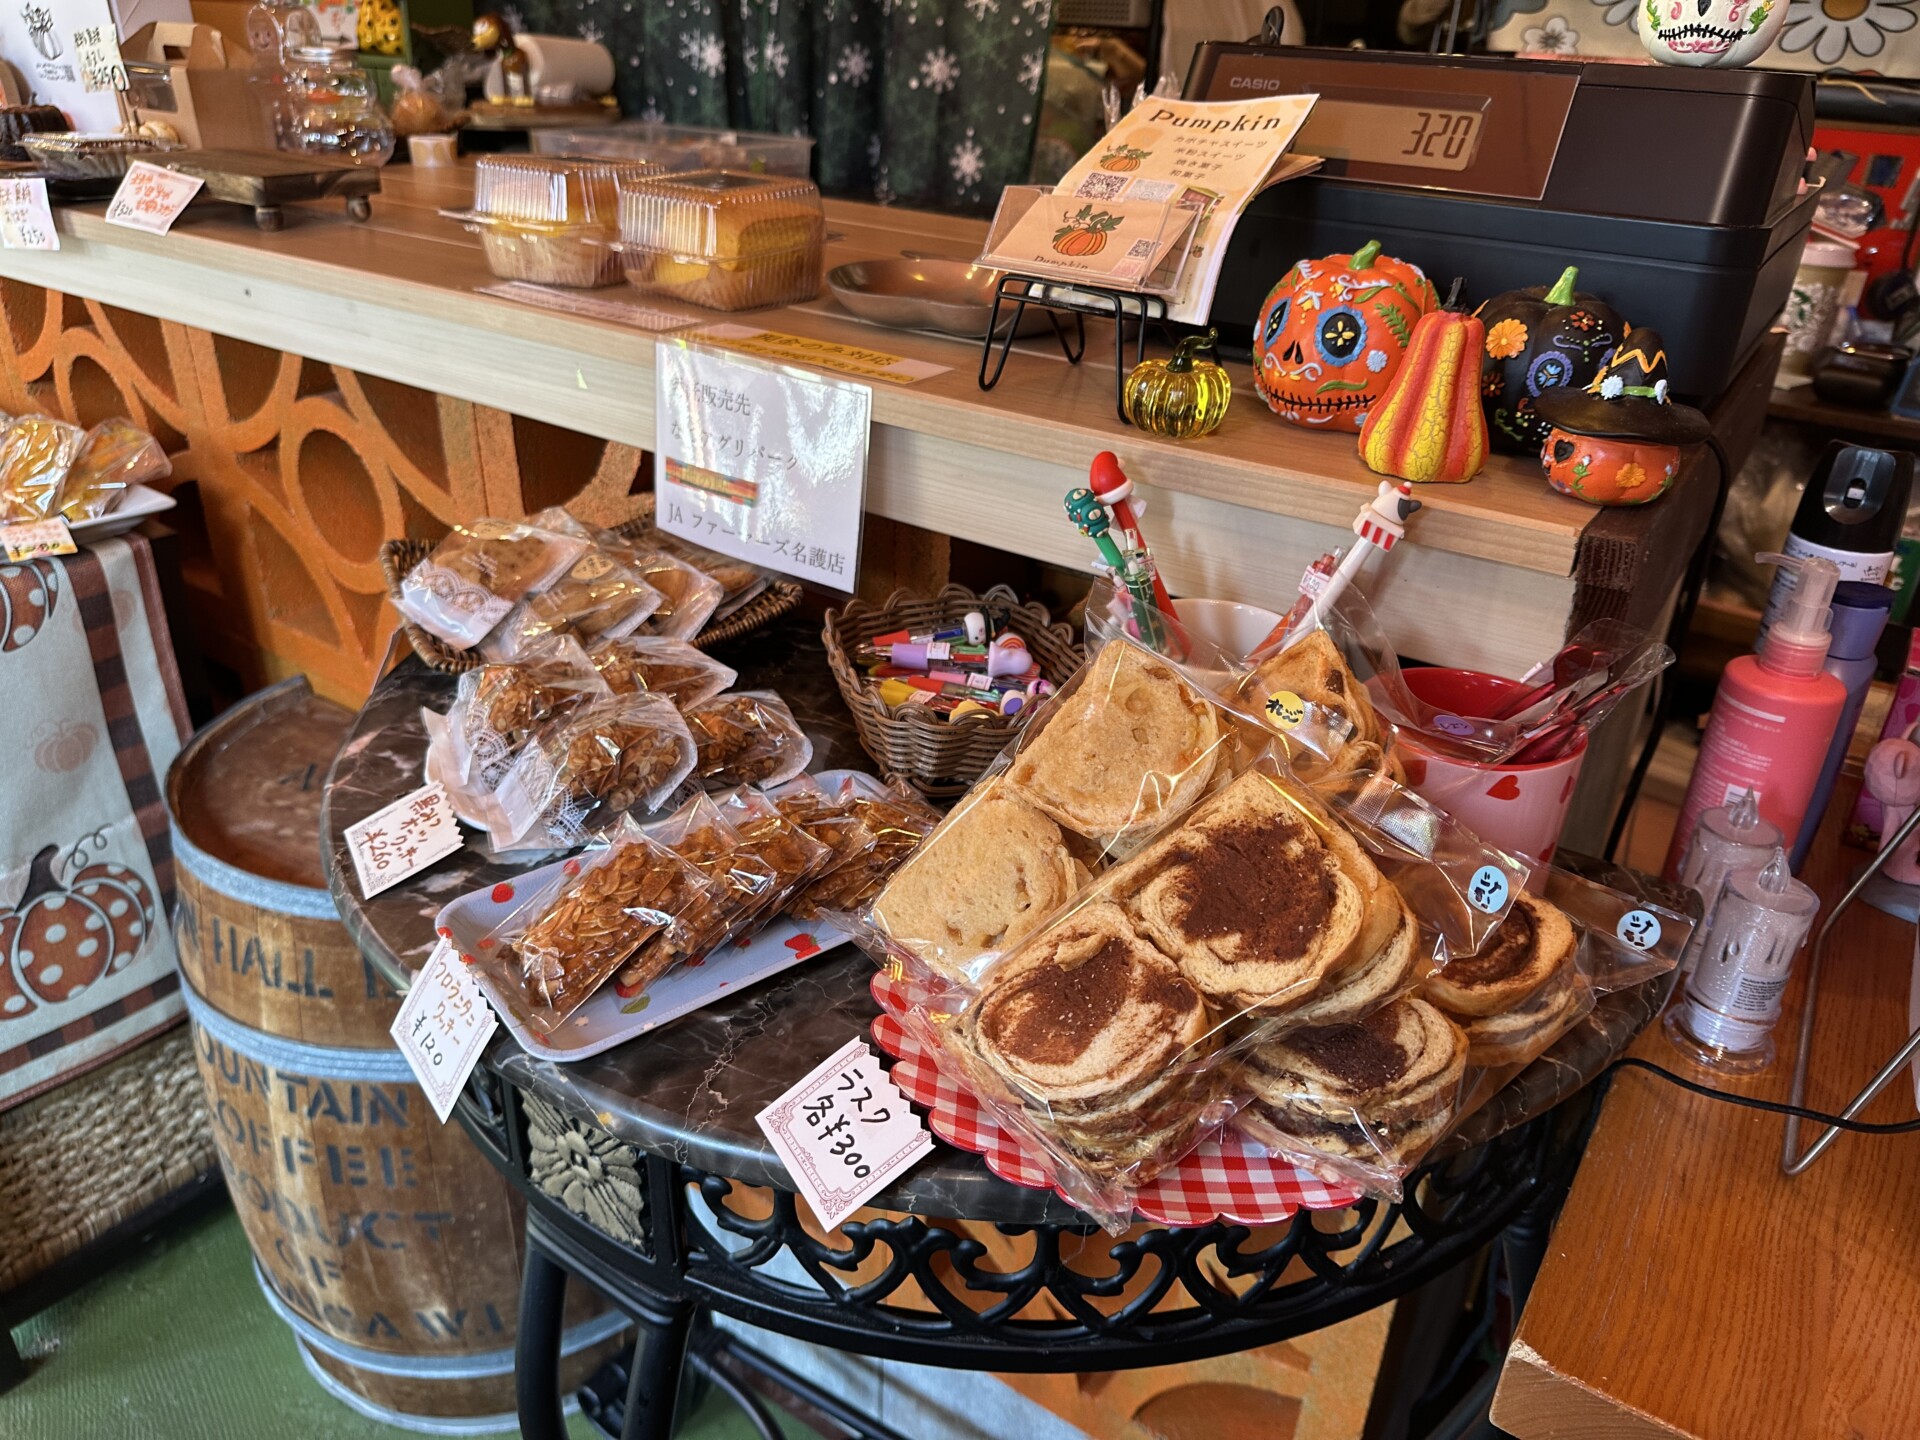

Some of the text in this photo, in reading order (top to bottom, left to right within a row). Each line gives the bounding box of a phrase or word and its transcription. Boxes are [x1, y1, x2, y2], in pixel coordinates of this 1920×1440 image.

[1229, 76, 1280, 91] CASIO
[1149, 108, 1281, 133] Pumpkin
[1173, 136, 1268, 149] カボチャスイーツ
[1402, 112, 1474, 160] 320
[1174, 147, 1247, 161] 米粉スイーツ
[667, 502, 684, 525] JA
[360, 828, 393, 870] ¥260
[212, 916, 335, 998] HALL
[412, 1009, 443, 1067] ¥120
[194, 1018, 411, 1128] OUNTAIN
[837, 1068, 891, 1124] ラスク
[206, 1080, 419, 1189] OFFEE
[802, 1094, 872, 1179] 各¥300
[216, 1150, 450, 1250] ODUCT
[275, 1237, 341, 1289] OF
